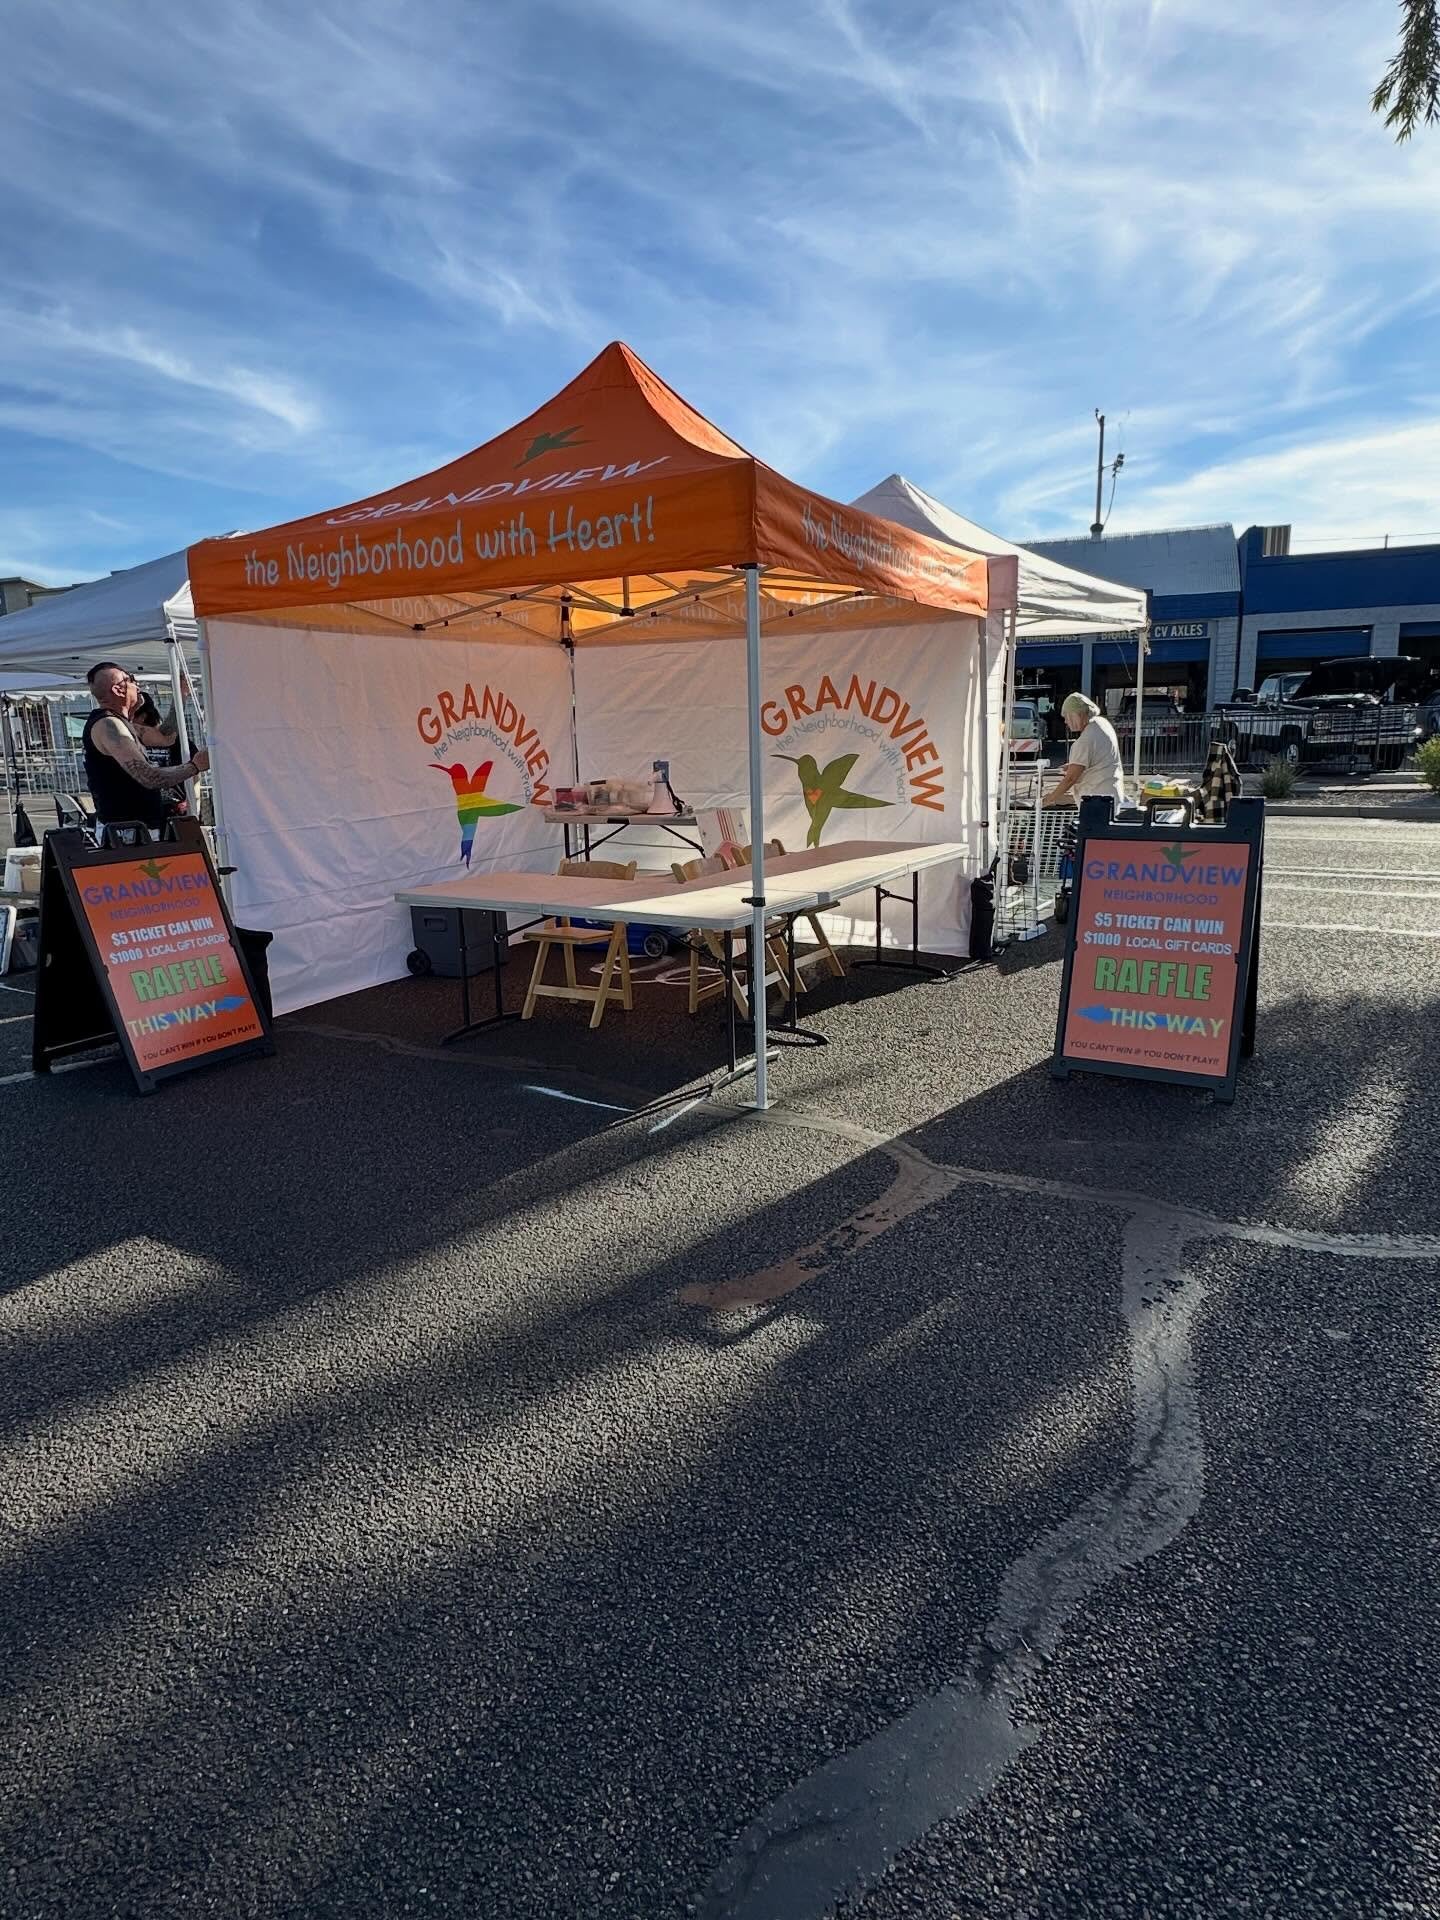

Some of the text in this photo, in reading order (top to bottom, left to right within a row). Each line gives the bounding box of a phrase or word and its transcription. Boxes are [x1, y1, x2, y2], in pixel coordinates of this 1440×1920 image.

[326, 455, 671, 526] GRANDVIEW
[244, 495, 657, 588] the Neighborhood with Heart!
[1154, 625, 1169, 638] CV
[1170, 623, 1204, 637] AXLES
[417, 683, 552, 806] GRANDVIEW
[433, 742, 449, 760] the
[448, 721, 510, 752] Neighborhood
[507, 750, 525, 773] with
[760, 674, 945, 812] GRANDVIEW
[776, 735, 794, 752] the
[793, 713, 884, 742] Neighborhood
[879, 739, 899, 766] with
[1085, 860, 1246, 887] GRANDVIEW
[83, 873, 209, 907] GRANDVIEW
[1103, 889, 1218, 905] NEIGHBORHOOD
[109, 897, 200, 920] NEIGHBORHOOD
[1094, 912, 1225, 935] $5 TICKET CAN WIN
[111, 916, 214, 947] $5 TICKET CAN WIN
[1083, 931, 1232, 955] $1000 LOCAL GIFT CARDS
[109, 934, 226, 965] $1000 LOCAL GIFT CARDS
[129, 954, 228, 1002] RAFFLE
[1094, 955, 1214, 1001] RAFFLE
[126, 1000, 217, 1038] THIS WAY
[1109, 1007, 1225, 1039] THIS WAY
[143, 1052, 159, 1061] YOU
[159, 1045, 181, 1058] CAN'T
[202, 1035, 217, 1044] YOU
[217, 1030, 236, 1040] DON'T
[1070, 1040, 1088, 1049] YOU
[1089, 1042, 1116, 1053] CAN'T
[1143, 1049, 1162, 1058] YOU
[1163, 1052, 1191, 1062] DON'T
